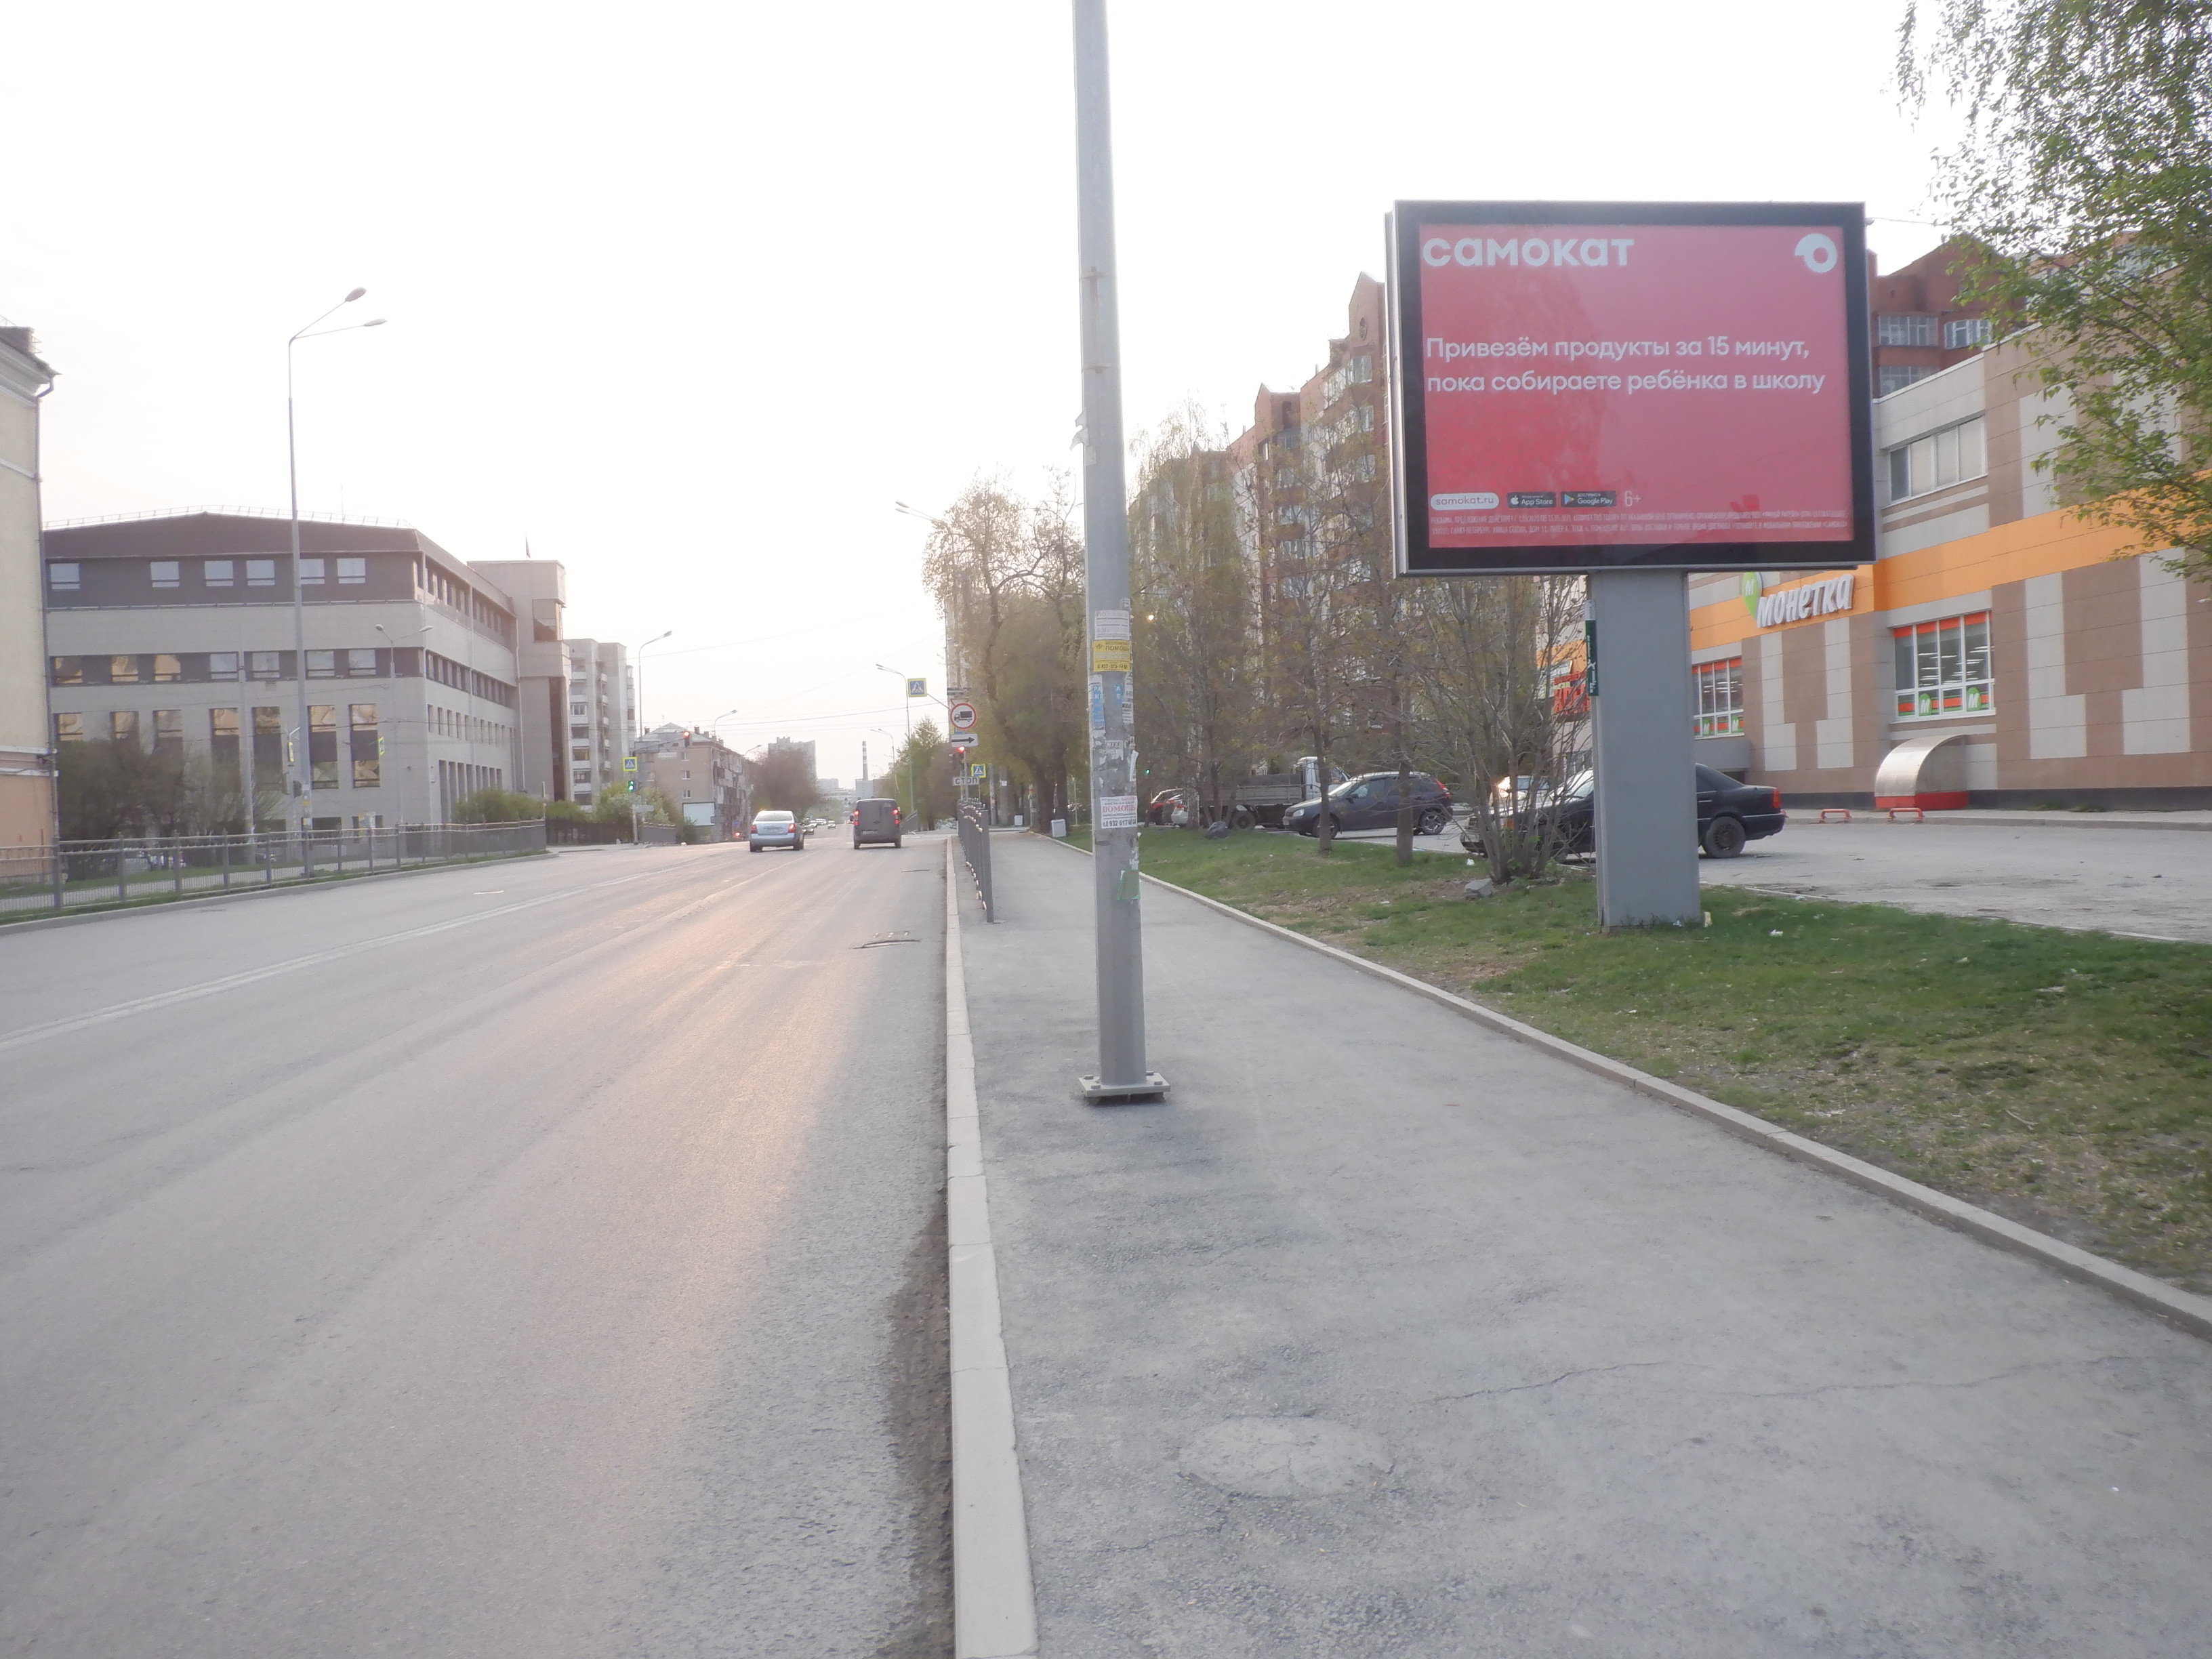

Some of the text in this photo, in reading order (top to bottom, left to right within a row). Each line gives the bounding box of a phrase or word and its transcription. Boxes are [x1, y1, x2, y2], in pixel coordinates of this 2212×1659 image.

[1423, 238, 1635, 266] самокат
[1427, 336, 1809, 362] Привезём продукты за 15 минут,
[1428, 369, 1825, 394] пока собираете ребёнка в школу
[1435, 495, 1494, 506] samokat.ru
[1521, 498, 1534, 506] App
[1577, 497, 1599, 506] Google
[1625, 491, 1641, 507] 6+
[1103, 804, 1136, 813] ПОМОЩЬ
